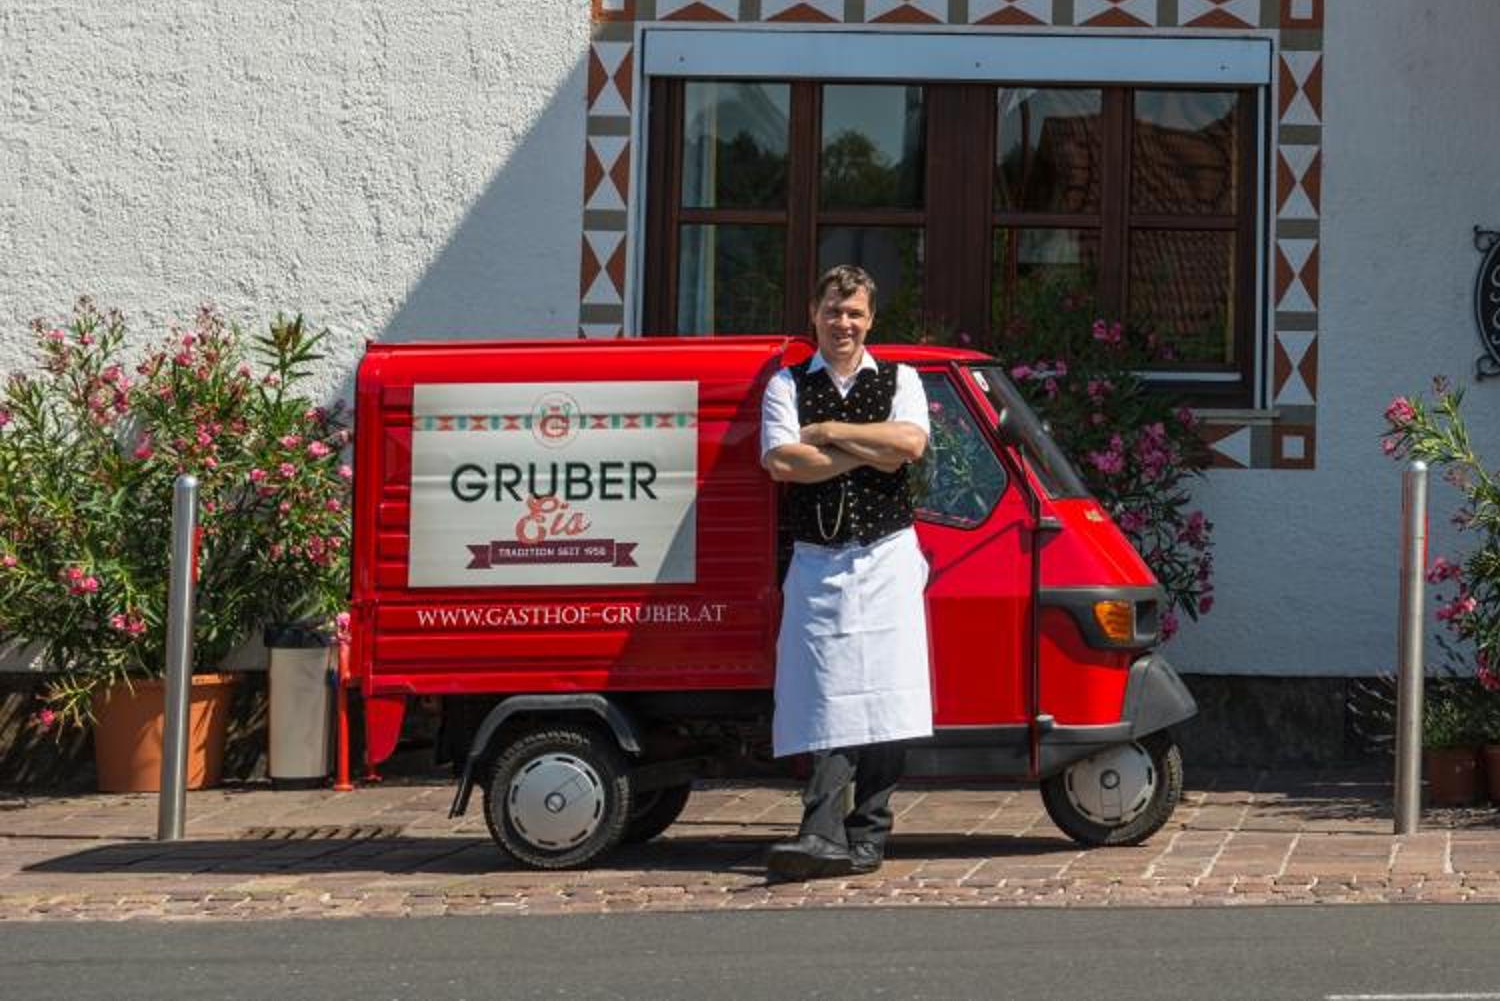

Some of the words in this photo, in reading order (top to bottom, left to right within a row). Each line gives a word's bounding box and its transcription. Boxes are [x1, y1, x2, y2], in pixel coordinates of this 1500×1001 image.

[450, 462, 658, 502] GRUBER
[515, 495, 593, 545] Eis
[416, 605, 727, 627] WWW.GASTHOF-GRUBER.AT
